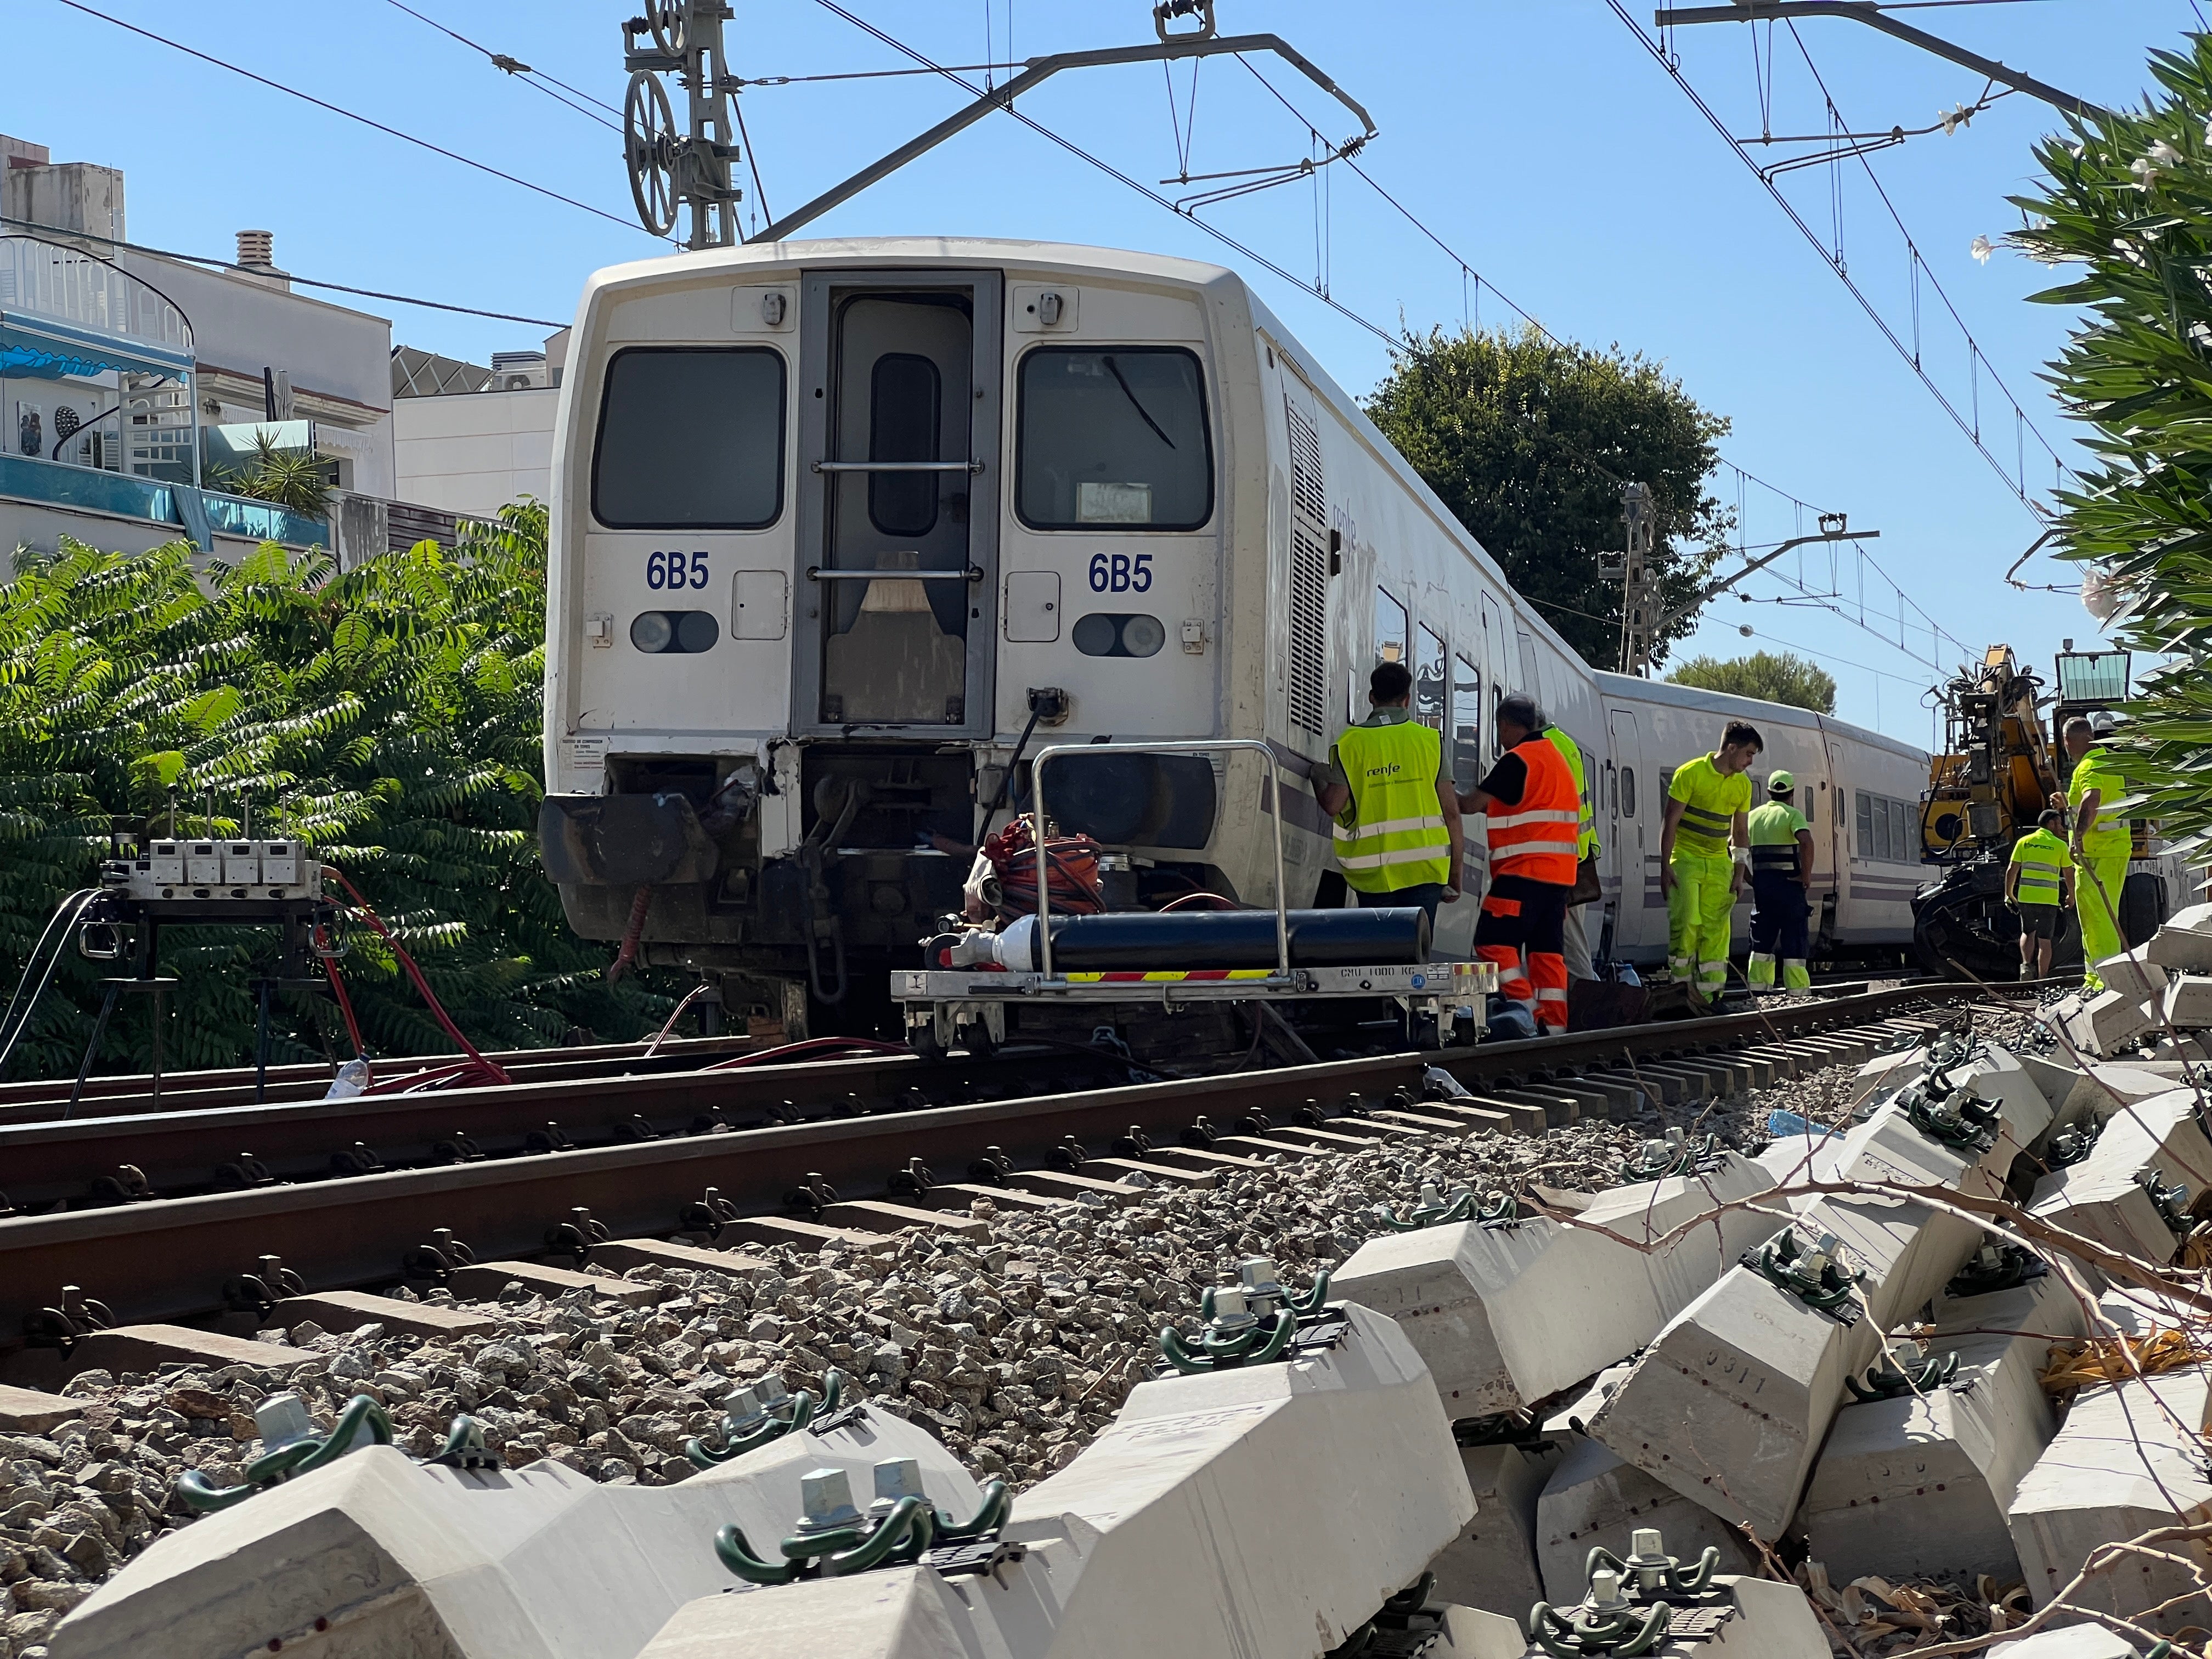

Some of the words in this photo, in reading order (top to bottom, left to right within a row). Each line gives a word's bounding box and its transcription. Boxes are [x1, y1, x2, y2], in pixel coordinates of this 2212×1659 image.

[647, 551, 709, 590] 6B5
[1089, 553, 1153, 592] 6B5
[1367, 761, 1400, 777] renfe
[1370, 967, 1394, 976] 1000
[1402, 967, 1415, 975] KG
